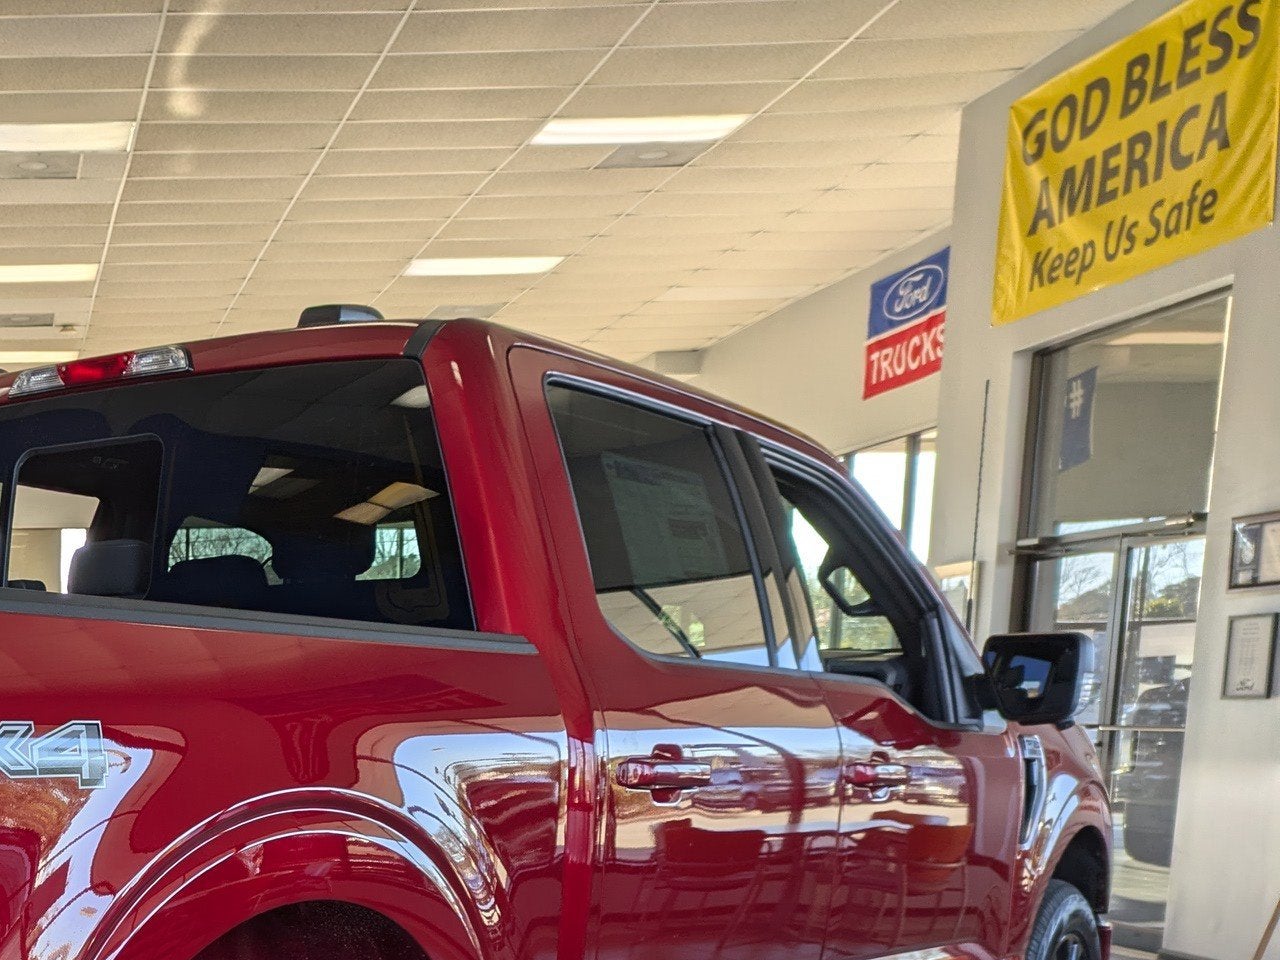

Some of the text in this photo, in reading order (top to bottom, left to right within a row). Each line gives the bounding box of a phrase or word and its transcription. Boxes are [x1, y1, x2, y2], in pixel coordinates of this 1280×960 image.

[1022, 0, 1261, 167] GOD BLESS
[1027, 91, 1230, 237] AMERICA
[894, 273, 933, 313] Ford
[1029, 179, 1219, 292] Keep Us Safe
